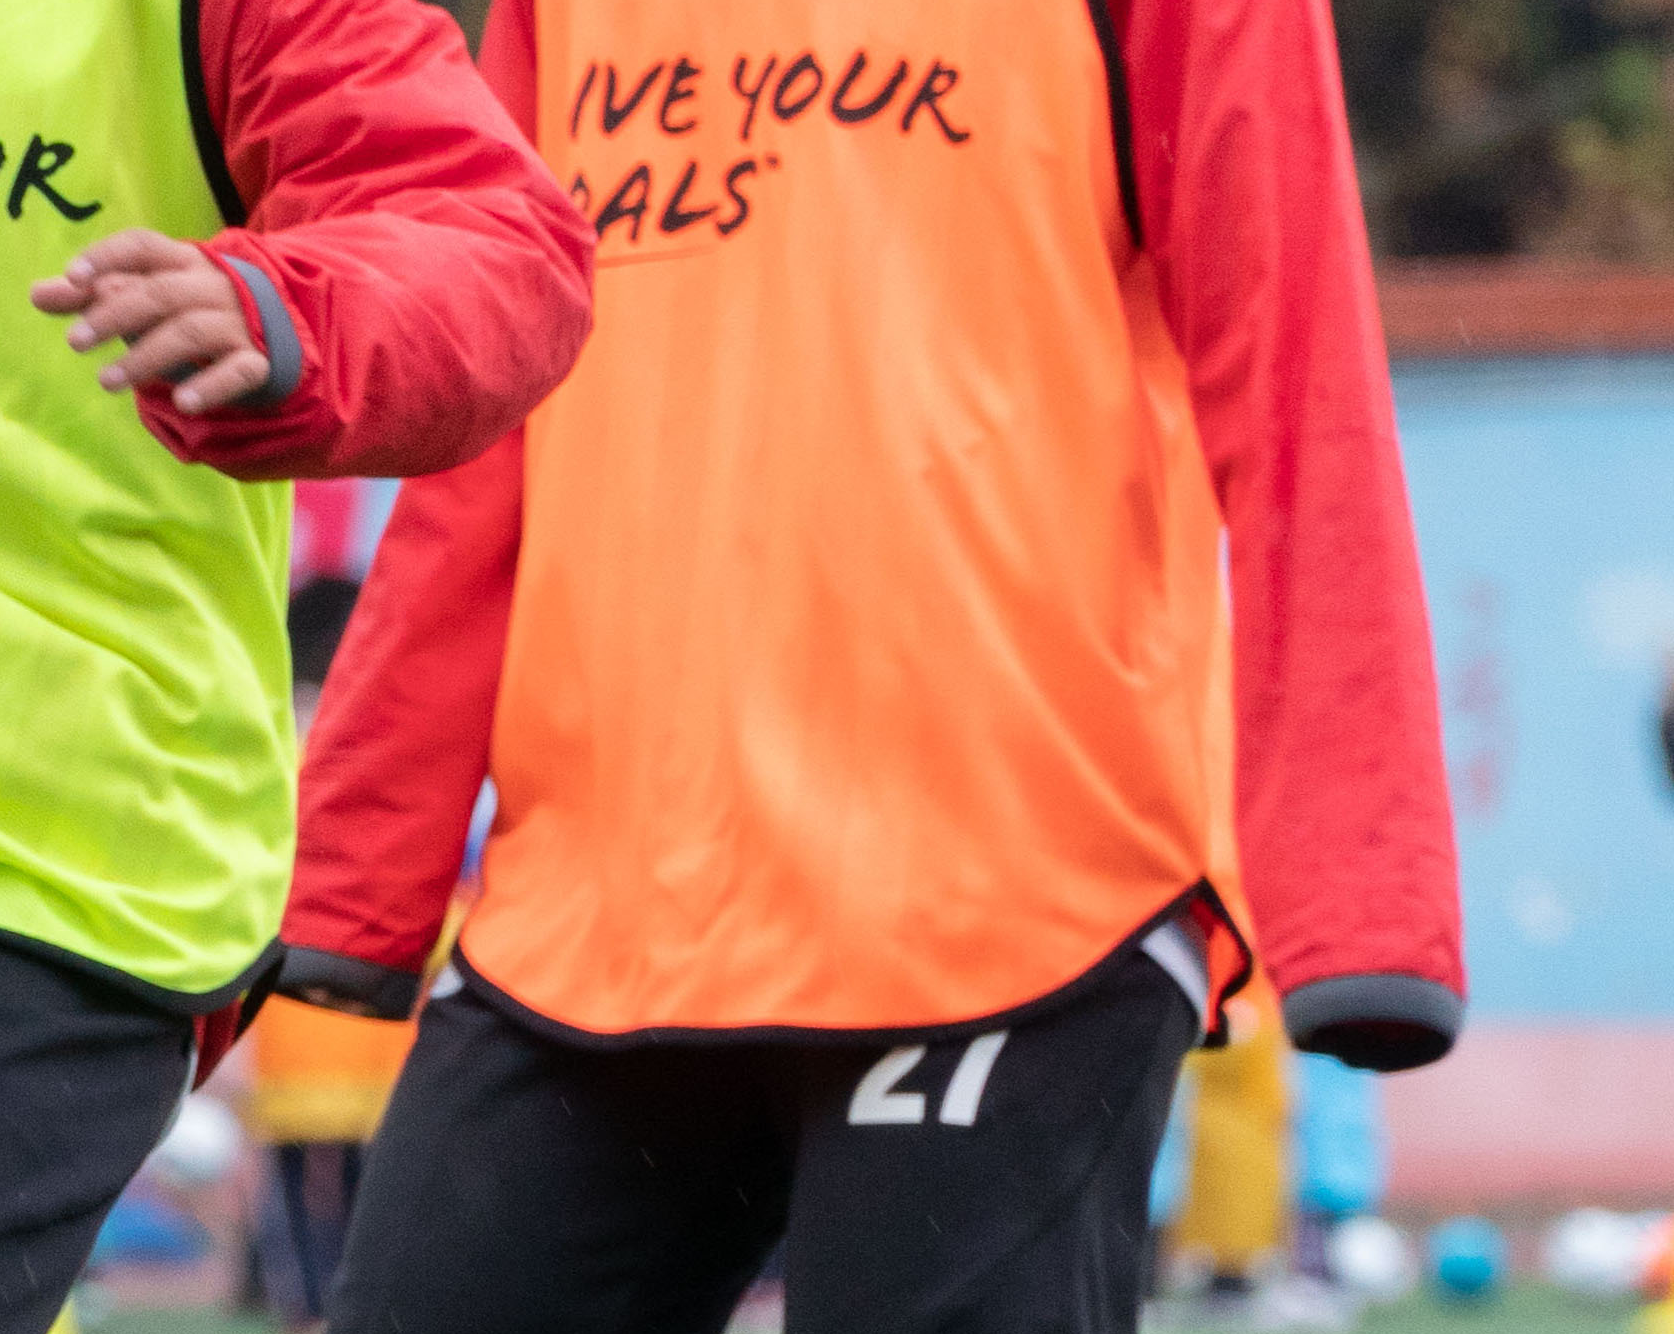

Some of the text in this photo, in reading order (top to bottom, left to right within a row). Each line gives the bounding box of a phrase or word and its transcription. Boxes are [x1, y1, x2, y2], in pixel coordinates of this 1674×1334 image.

[567, 51, 972, 144] IVE YOUR
[569, 160, 758, 243] ALS
